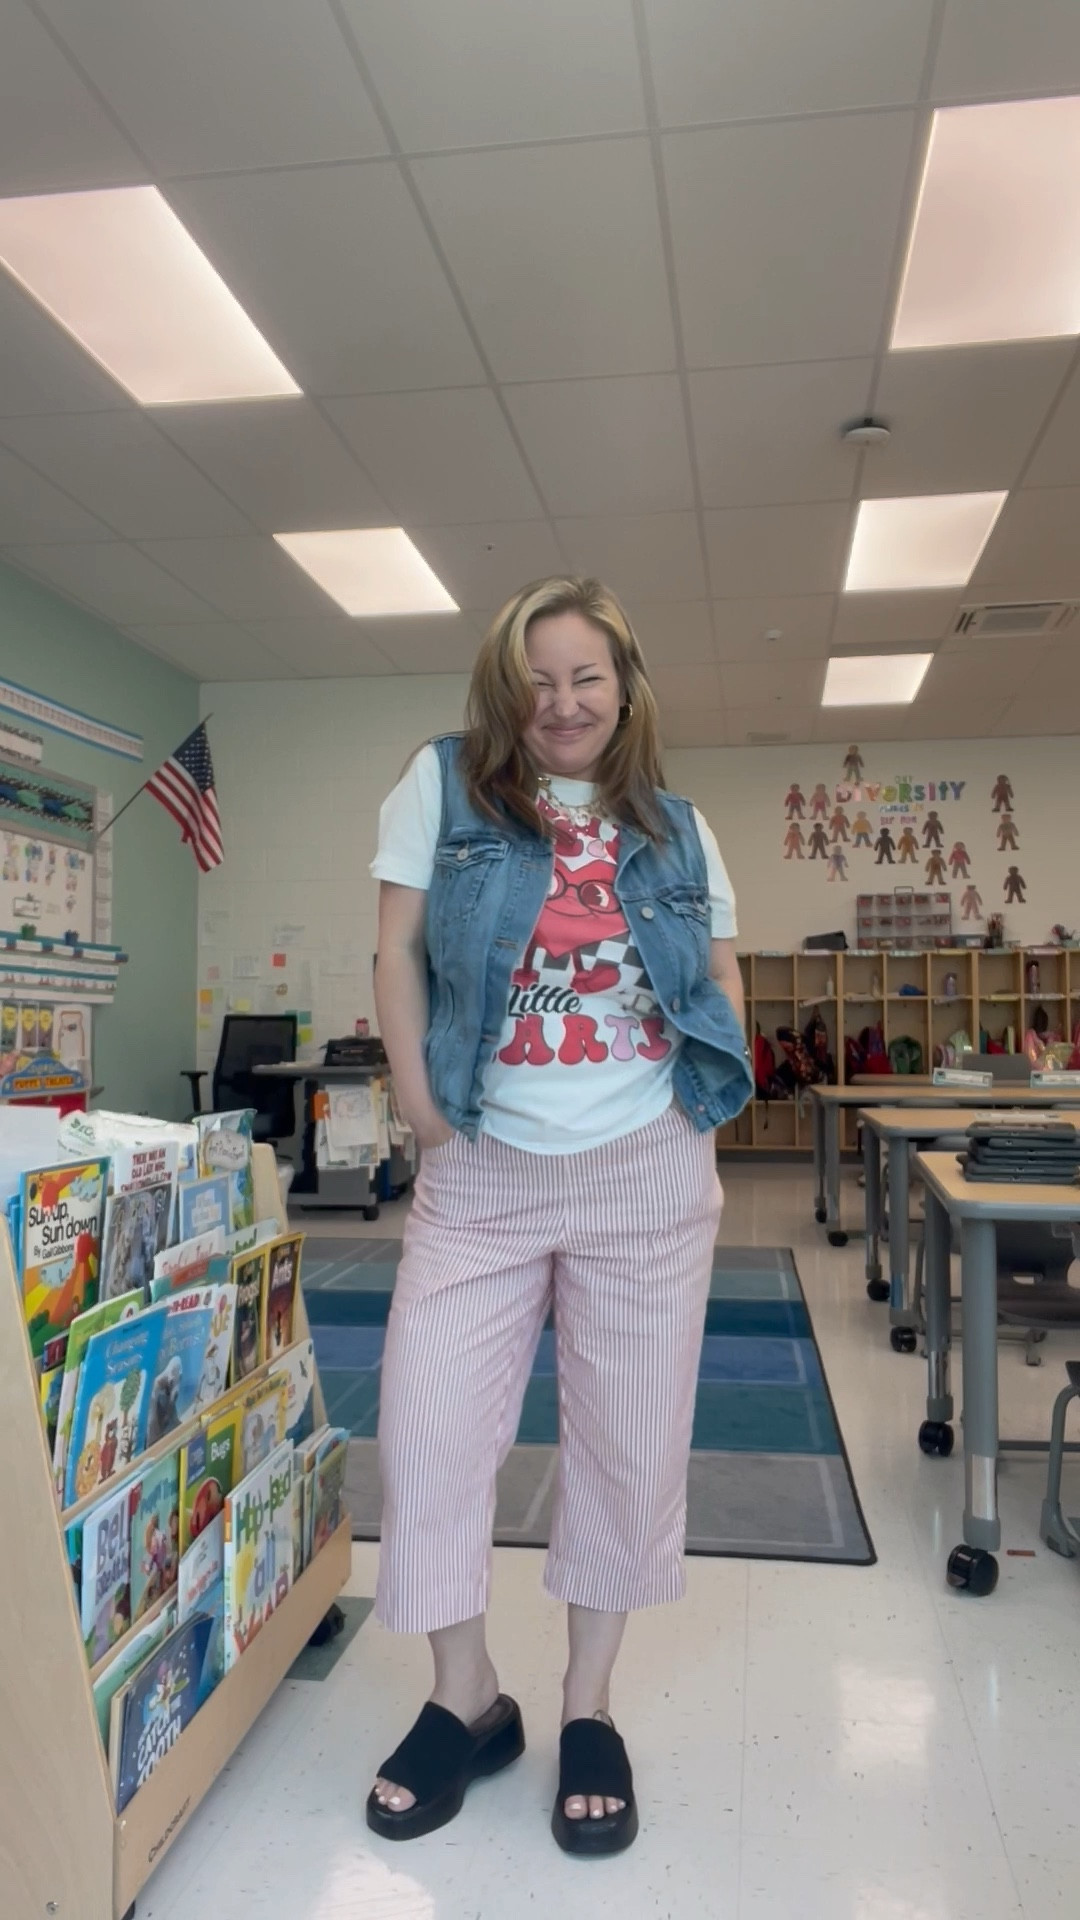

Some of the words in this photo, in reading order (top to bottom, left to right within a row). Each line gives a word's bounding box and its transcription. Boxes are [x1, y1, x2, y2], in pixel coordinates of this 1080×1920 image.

[508, 984, 583, 1019] Little
[42, 1224, 64, 1246] Sun
[66, 1215, 97, 1239] down
[211, 1437, 231, 1463] Bugs
